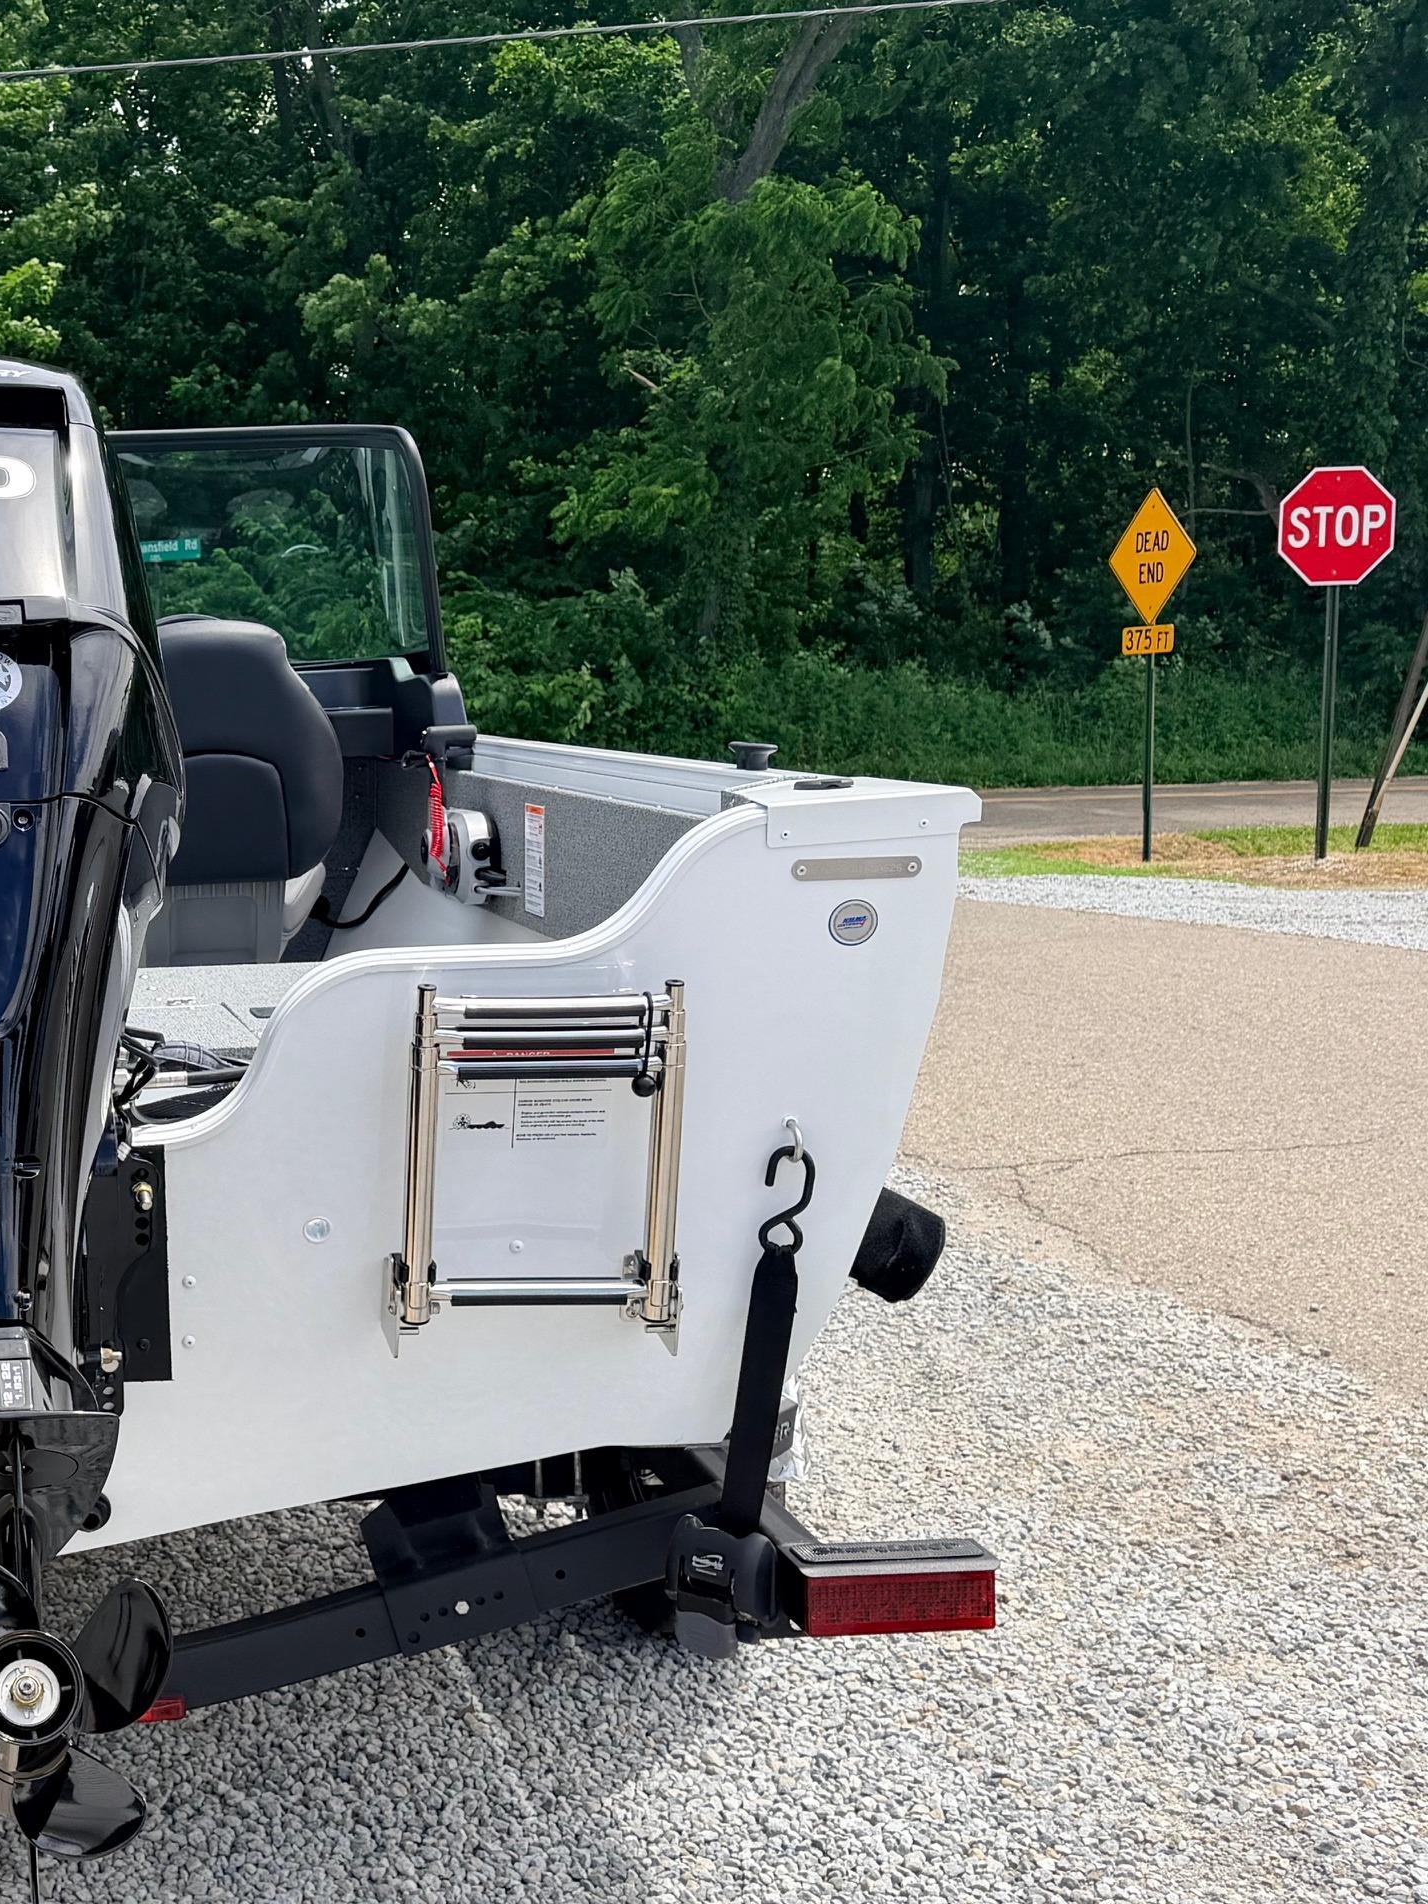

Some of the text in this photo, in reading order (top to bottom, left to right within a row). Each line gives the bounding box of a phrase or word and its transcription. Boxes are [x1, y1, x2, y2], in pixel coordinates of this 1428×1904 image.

[1287, 505, 1387, 549] STOP
[141, 539, 198, 553] ansfield Rd
[1135, 530, 1169, 553] DEAD
[1138, 562, 1164, 584] END
[1125, 629, 1169, 651] 375 FT
[0, 1362, 12, 1380] 22
[2, 1391, 14, 1407] 12
